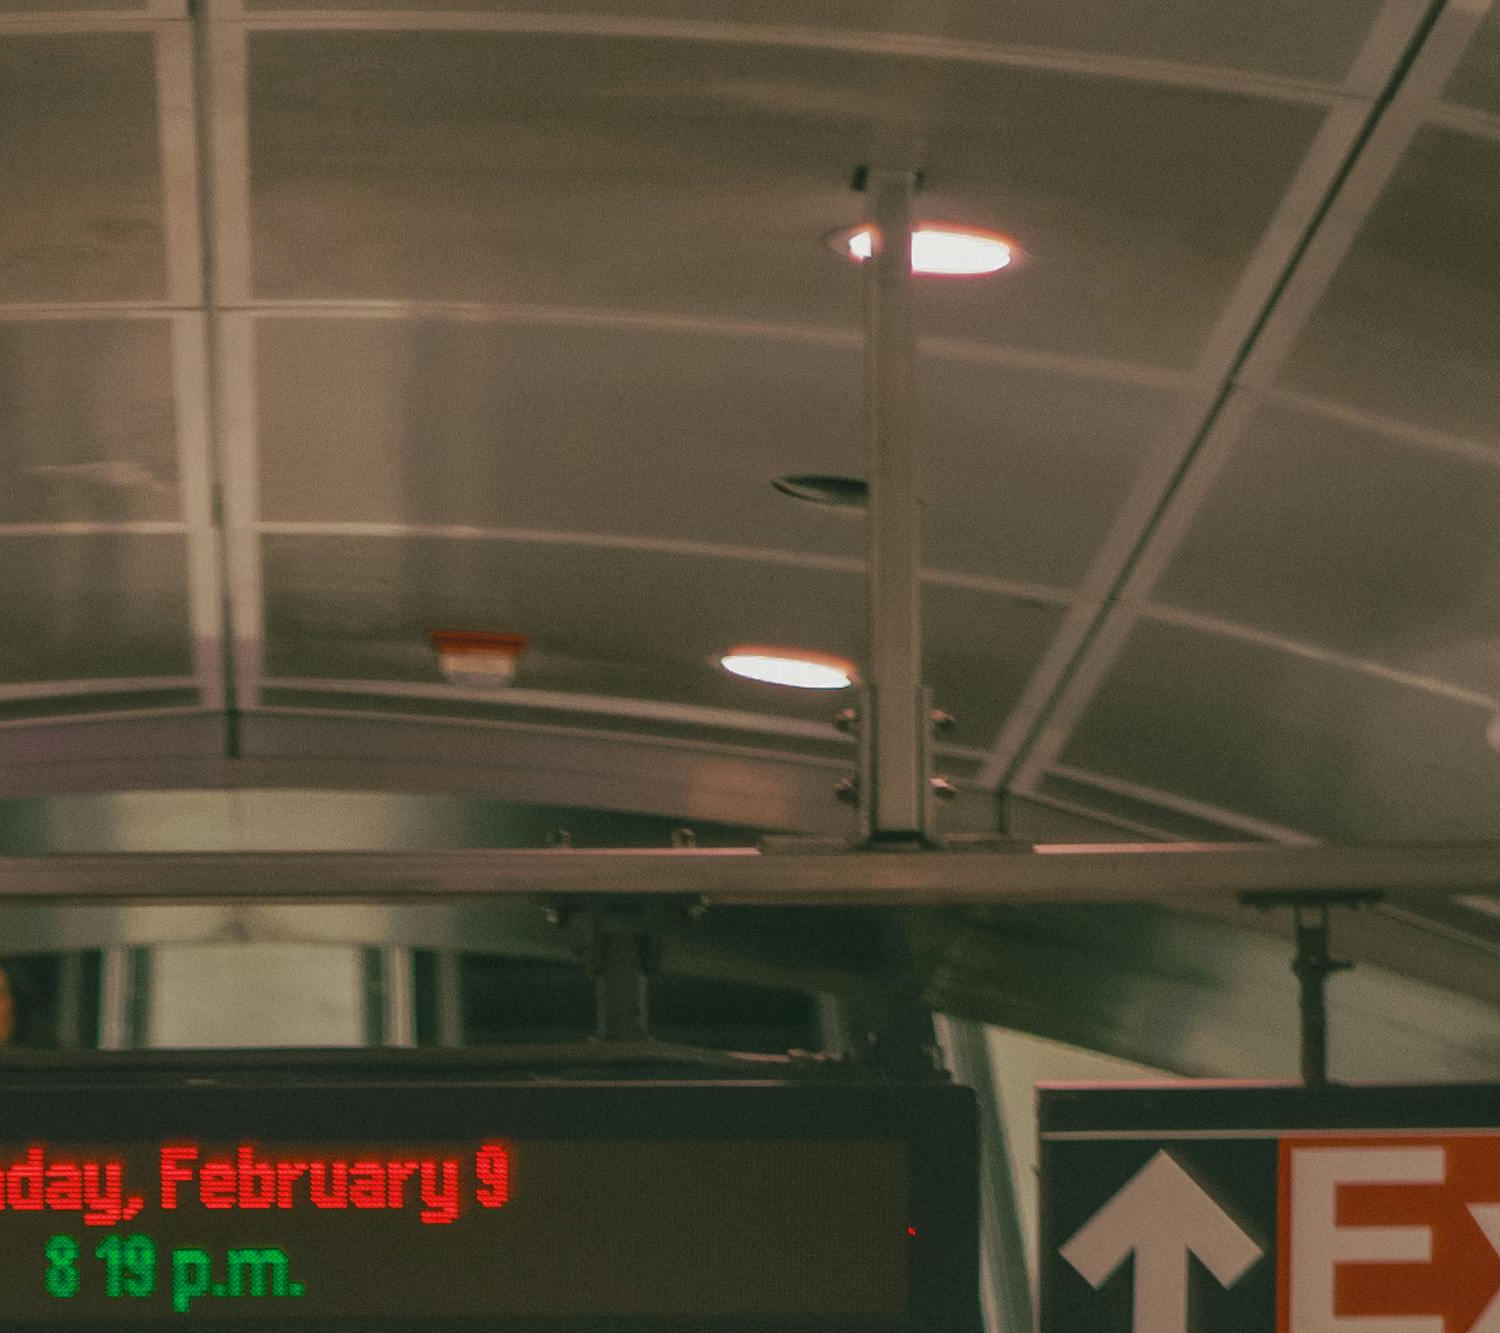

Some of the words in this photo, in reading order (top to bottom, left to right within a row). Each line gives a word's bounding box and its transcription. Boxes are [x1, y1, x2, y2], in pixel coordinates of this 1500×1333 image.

[160, 1147, 459, 1223] February
[475, 1145, 509, 1207] 9
[171, 1247, 306, 1312] p.m.
